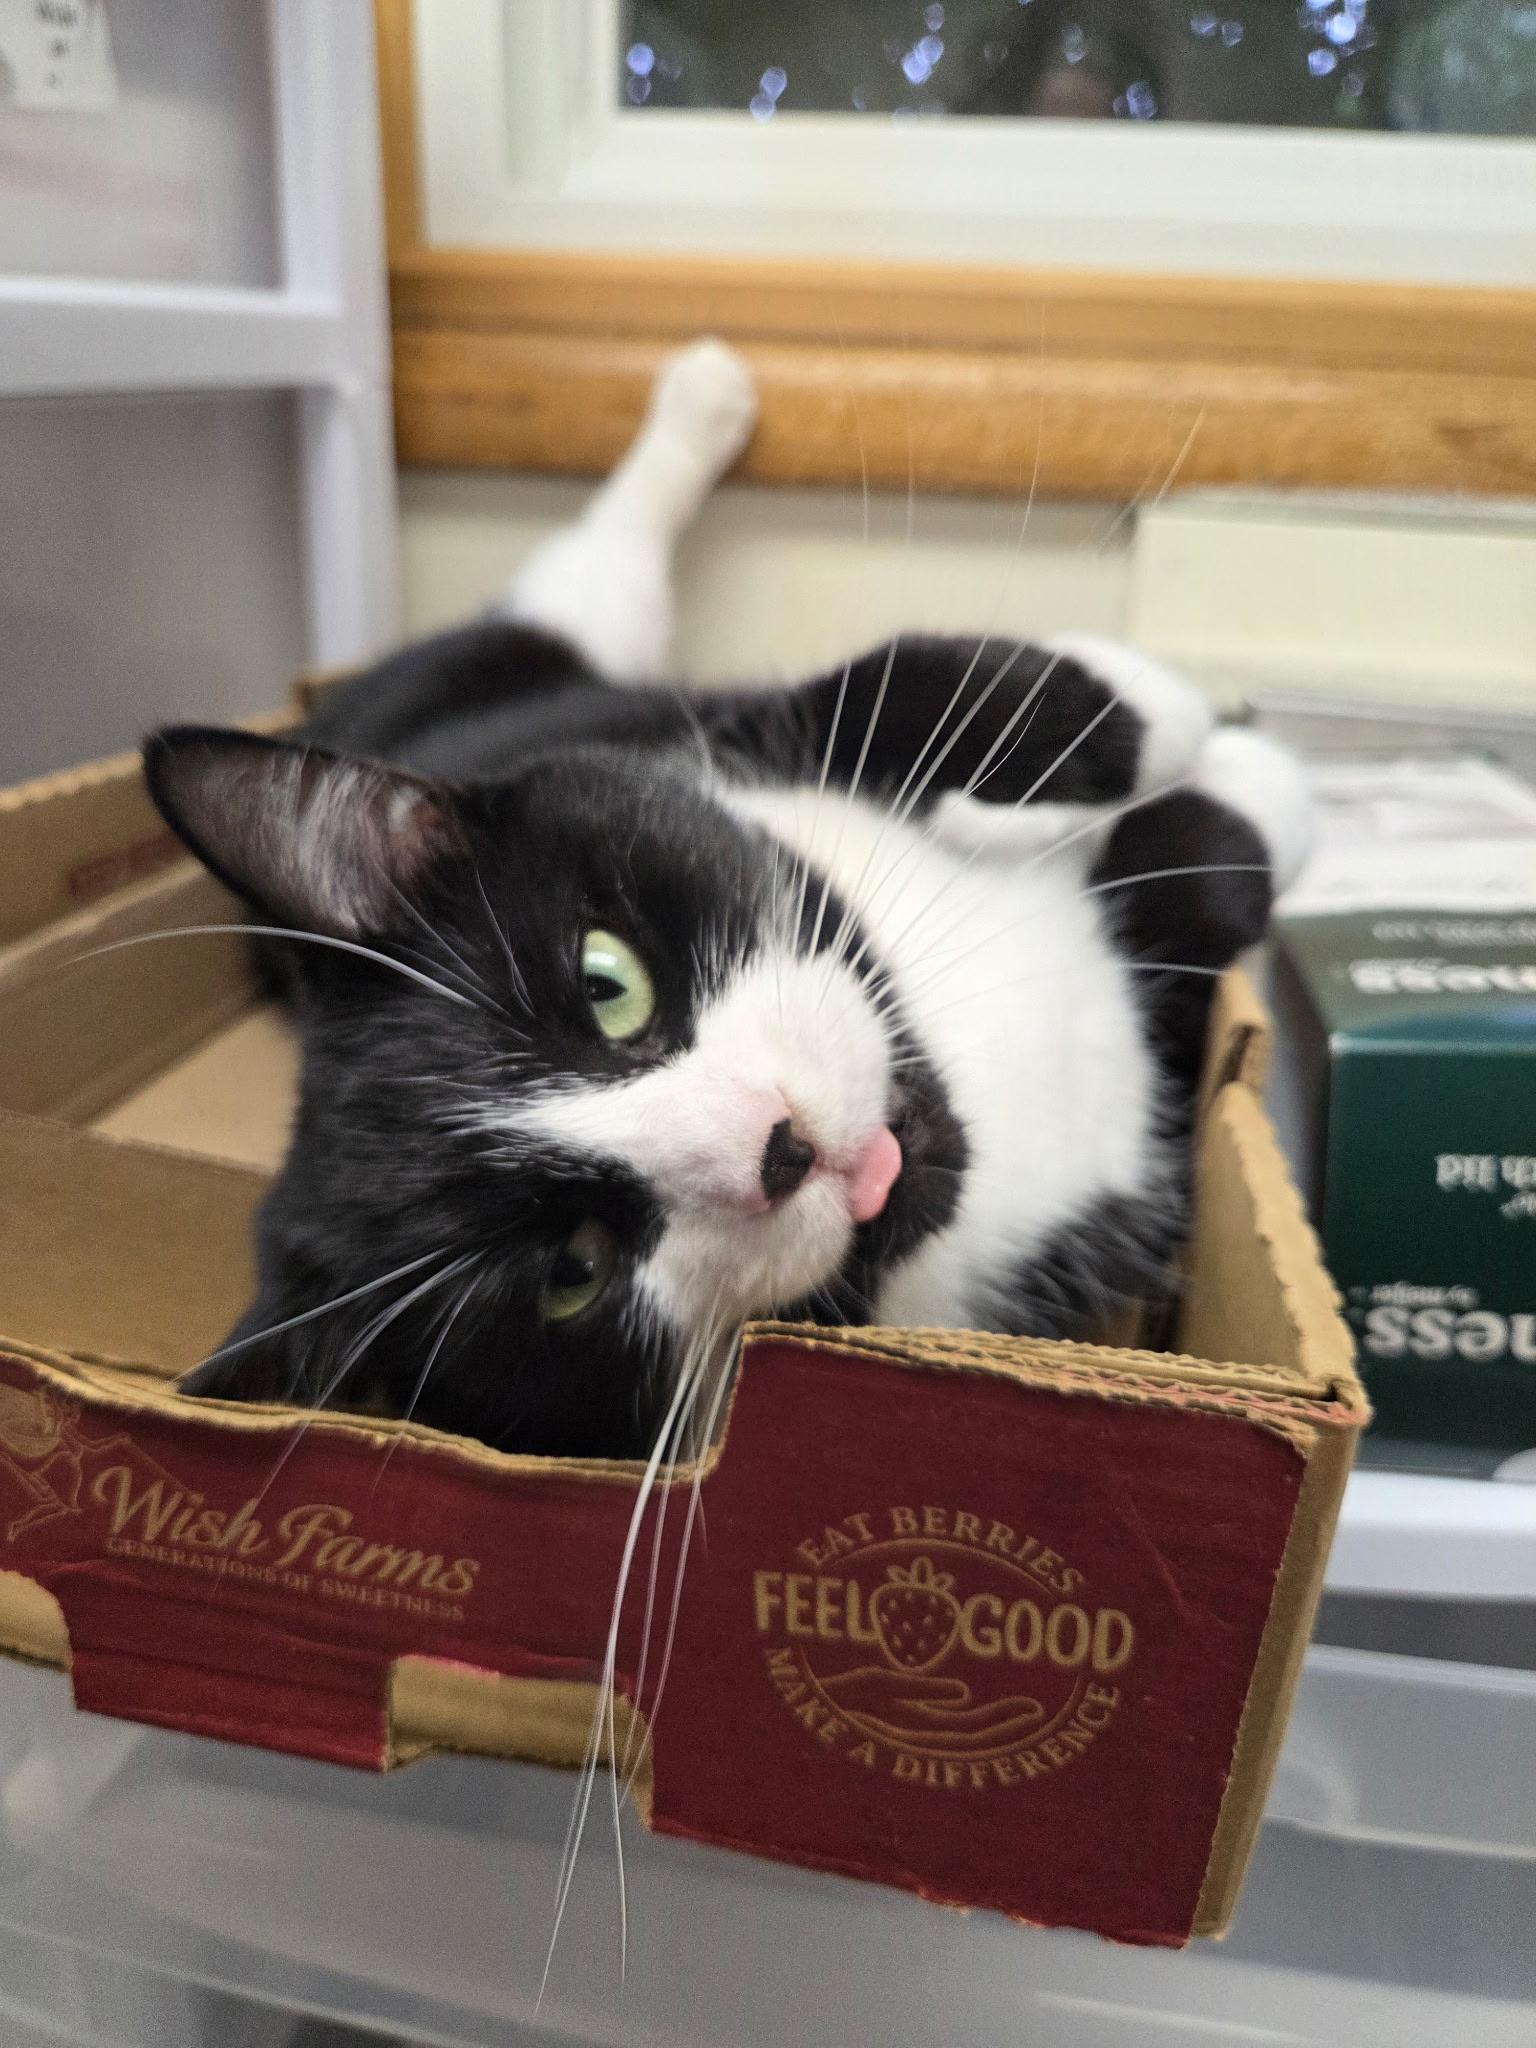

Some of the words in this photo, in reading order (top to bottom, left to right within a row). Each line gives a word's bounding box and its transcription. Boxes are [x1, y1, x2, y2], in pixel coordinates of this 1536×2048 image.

[93, 1465, 269, 1556] Wish
[279, 1503, 480, 1597] Farms
[106, 1537, 281, 1585] GENERATIONS
[282, 1569, 313, 1592] OF
[320, 1577, 466, 1622] SWEETNESS
[797, 1511, 874, 1567] EAT
[889, 1506, 1086, 1596] BERRIES
[753, 1570, 882, 1643] FEEL
[957, 1592, 1135, 1673] GOOD
[763, 1646, 849, 1743] MAKE
[849, 1740, 876, 1768] A
[892, 1682, 1121, 1790] DIFFERENCE
